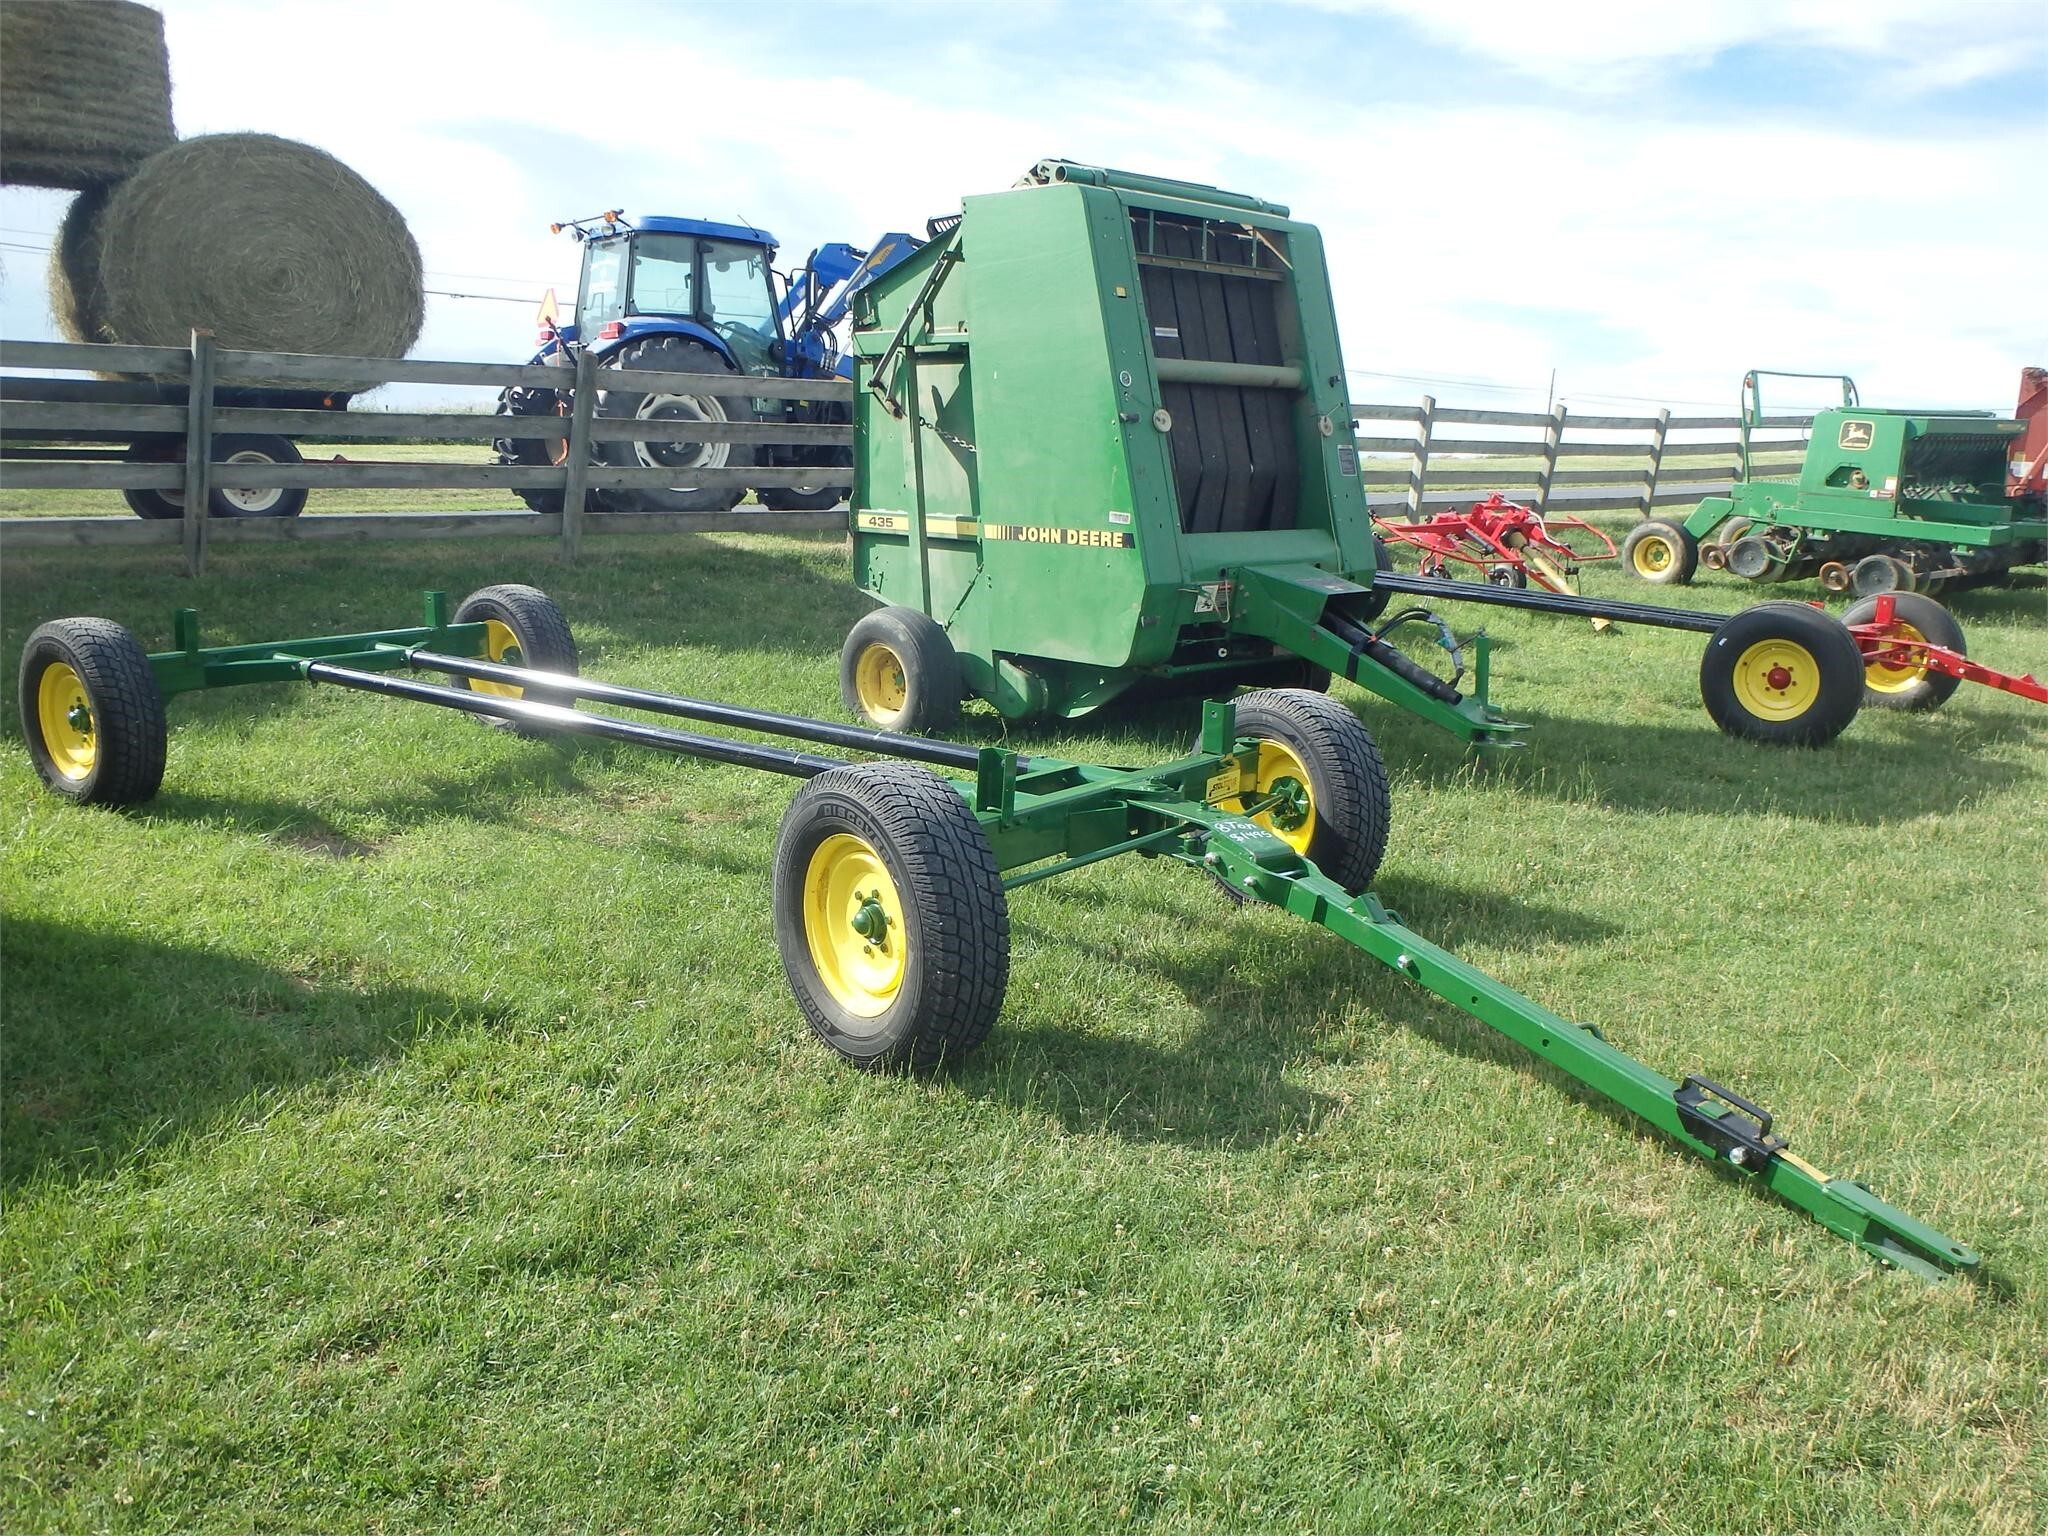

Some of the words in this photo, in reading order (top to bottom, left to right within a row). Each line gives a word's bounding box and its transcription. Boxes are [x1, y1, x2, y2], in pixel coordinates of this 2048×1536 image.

[868, 517, 894, 528] 435
[1018, 526, 1061, 544] JOHN
[1066, 529, 1123, 548] DEERE
